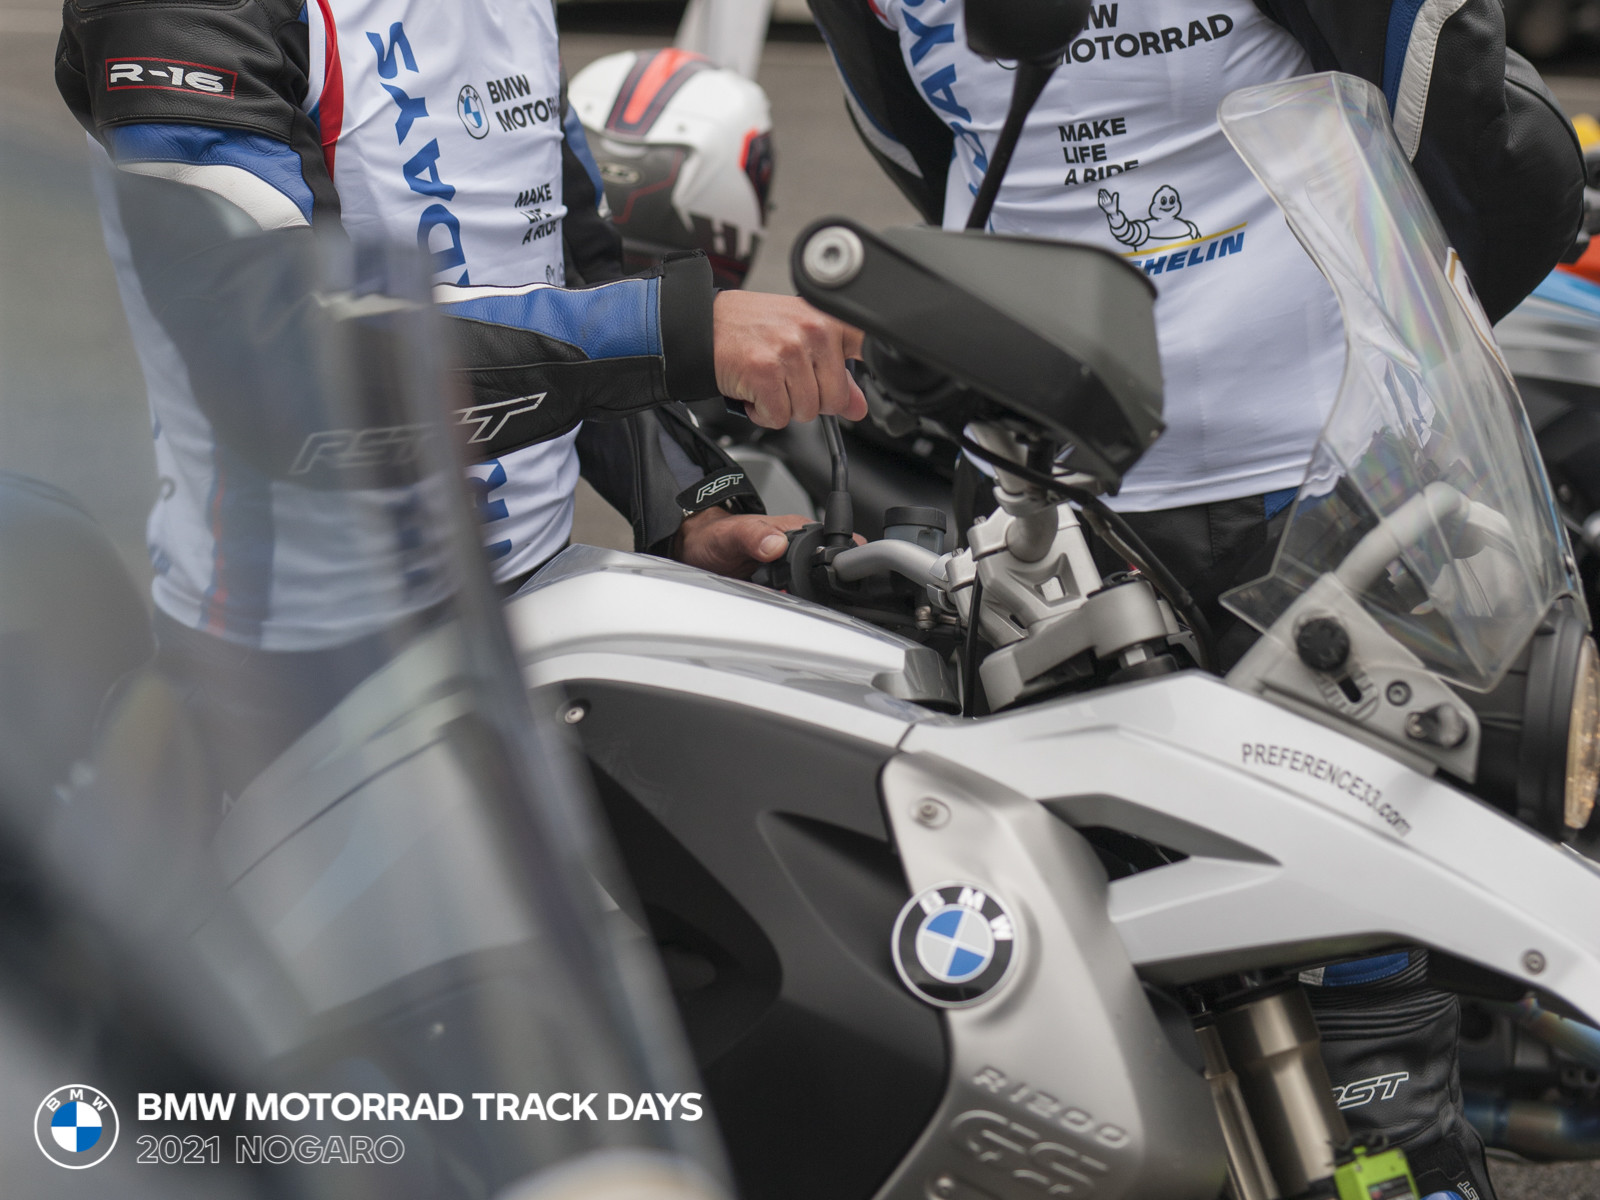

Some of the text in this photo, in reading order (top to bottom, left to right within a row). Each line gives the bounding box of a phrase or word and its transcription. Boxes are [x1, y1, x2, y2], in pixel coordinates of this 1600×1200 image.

[110, 63, 224, 93] R-16
[486, 74, 531, 104] BMW
[1058, 117, 1127, 142] MAKE
[366, 21, 467, 276] DAYS
[1063, 143, 1107, 164] LIFE
[1064, 168, 1079, 186] A
[515, 183, 552, 208] MAKE
[1132, 231, 1245, 276] HELIN
[696, 473, 744, 504] RST
